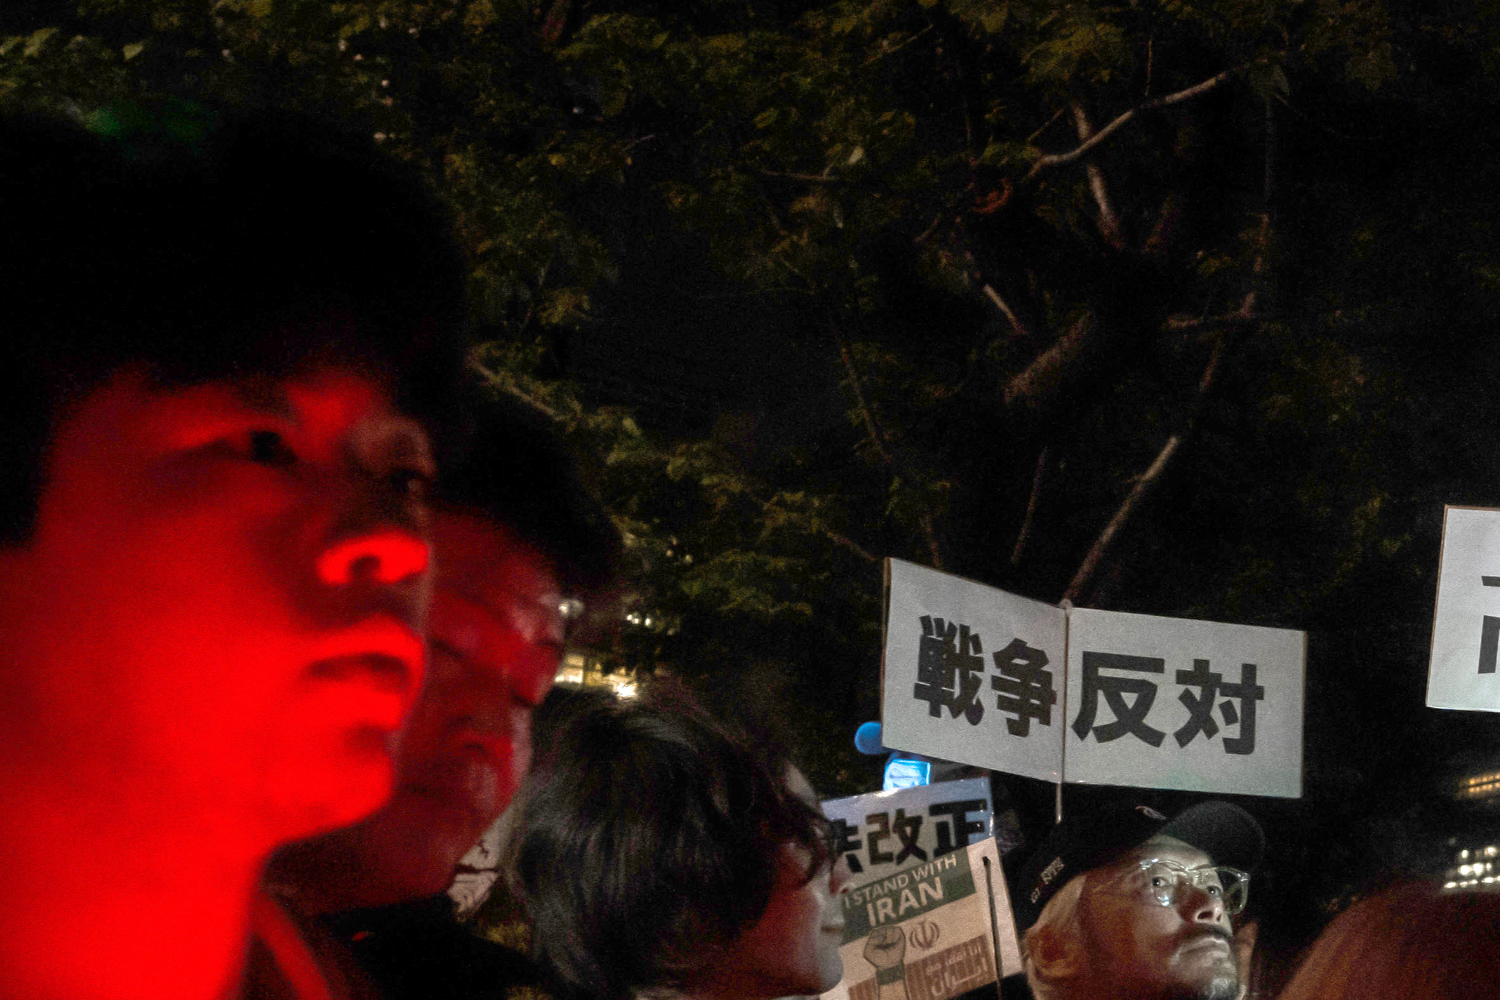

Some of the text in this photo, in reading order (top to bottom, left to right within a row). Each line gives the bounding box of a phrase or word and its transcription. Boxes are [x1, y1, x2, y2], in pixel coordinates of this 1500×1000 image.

[913, 615, 1265, 755] 戦争反対
[853, 874, 909, 906] STAND
[912, 853, 957, 881] WITH
[866, 876, 944, 927] IRAN
